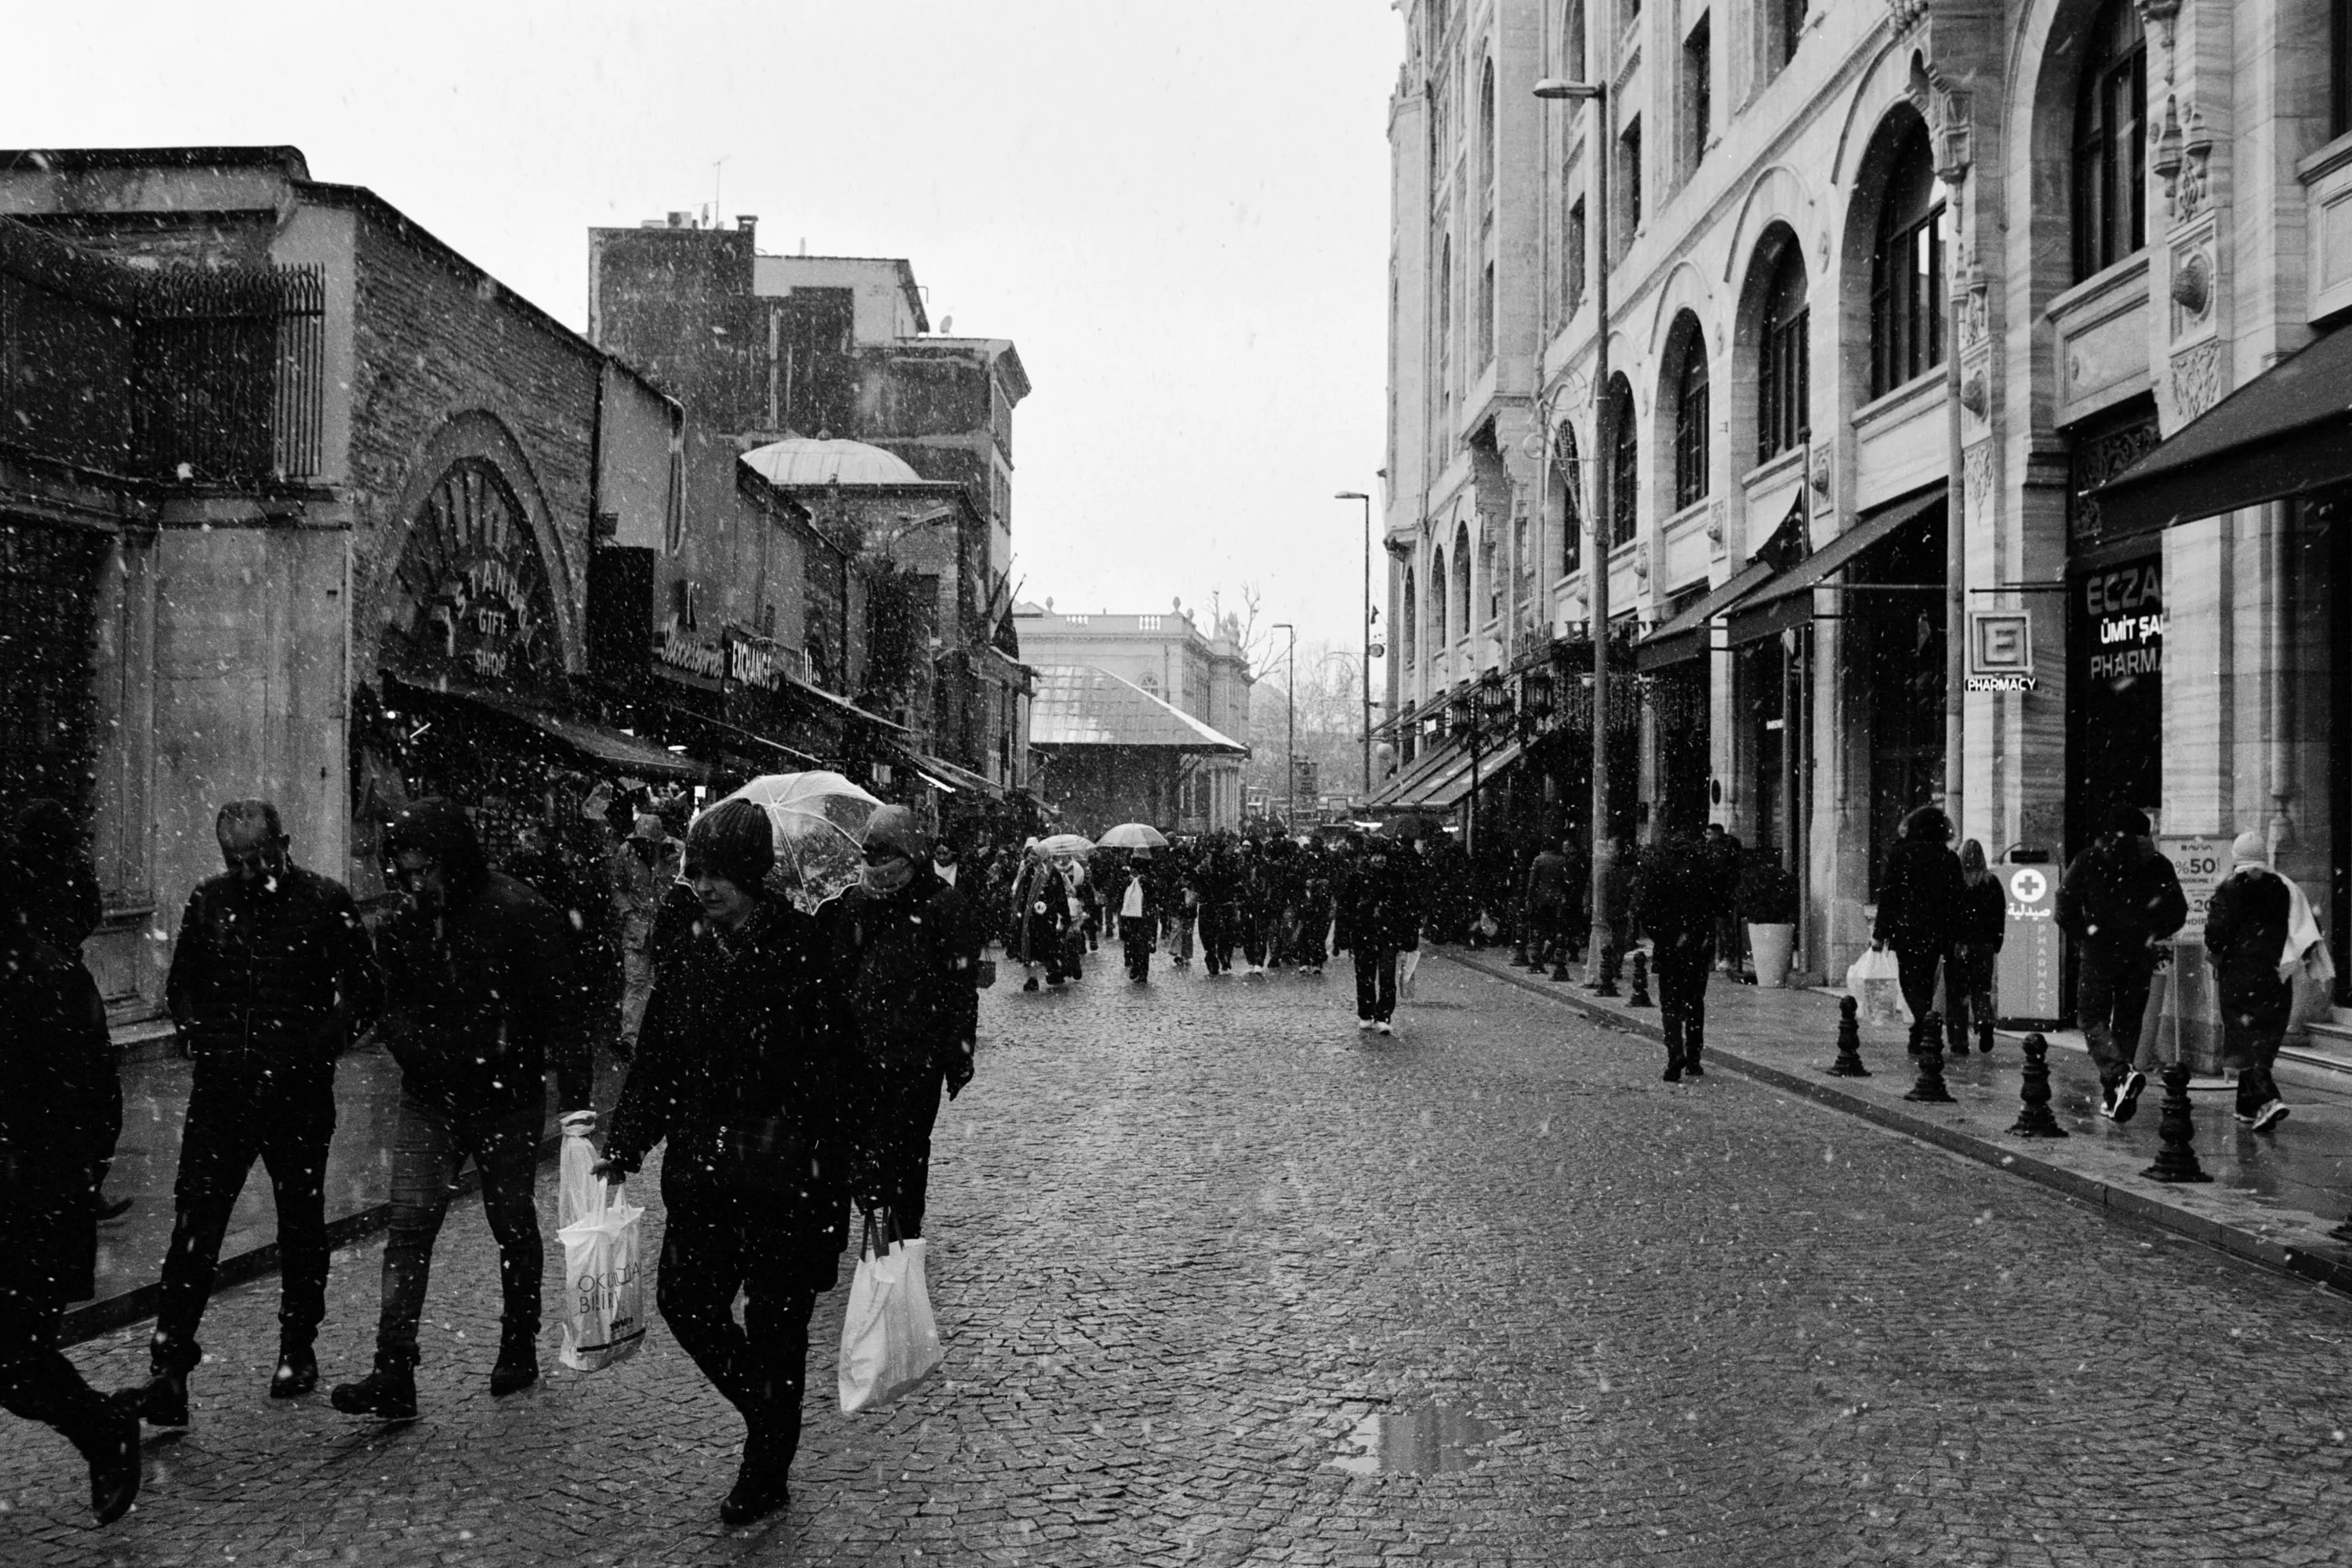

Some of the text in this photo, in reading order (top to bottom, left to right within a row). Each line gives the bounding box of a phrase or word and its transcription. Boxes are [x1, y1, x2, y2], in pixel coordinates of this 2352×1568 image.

[478, 608, 506, 637] GIFT
[2100, 614, 2136, 644] ÜMİT
[474, 648, 506, 677] SHOP
[1967, 677, 2036, 691] PHARMACY
[2175, 858, 2216, 874] %50
[2007, 902, 2051, 921] صيدلية
